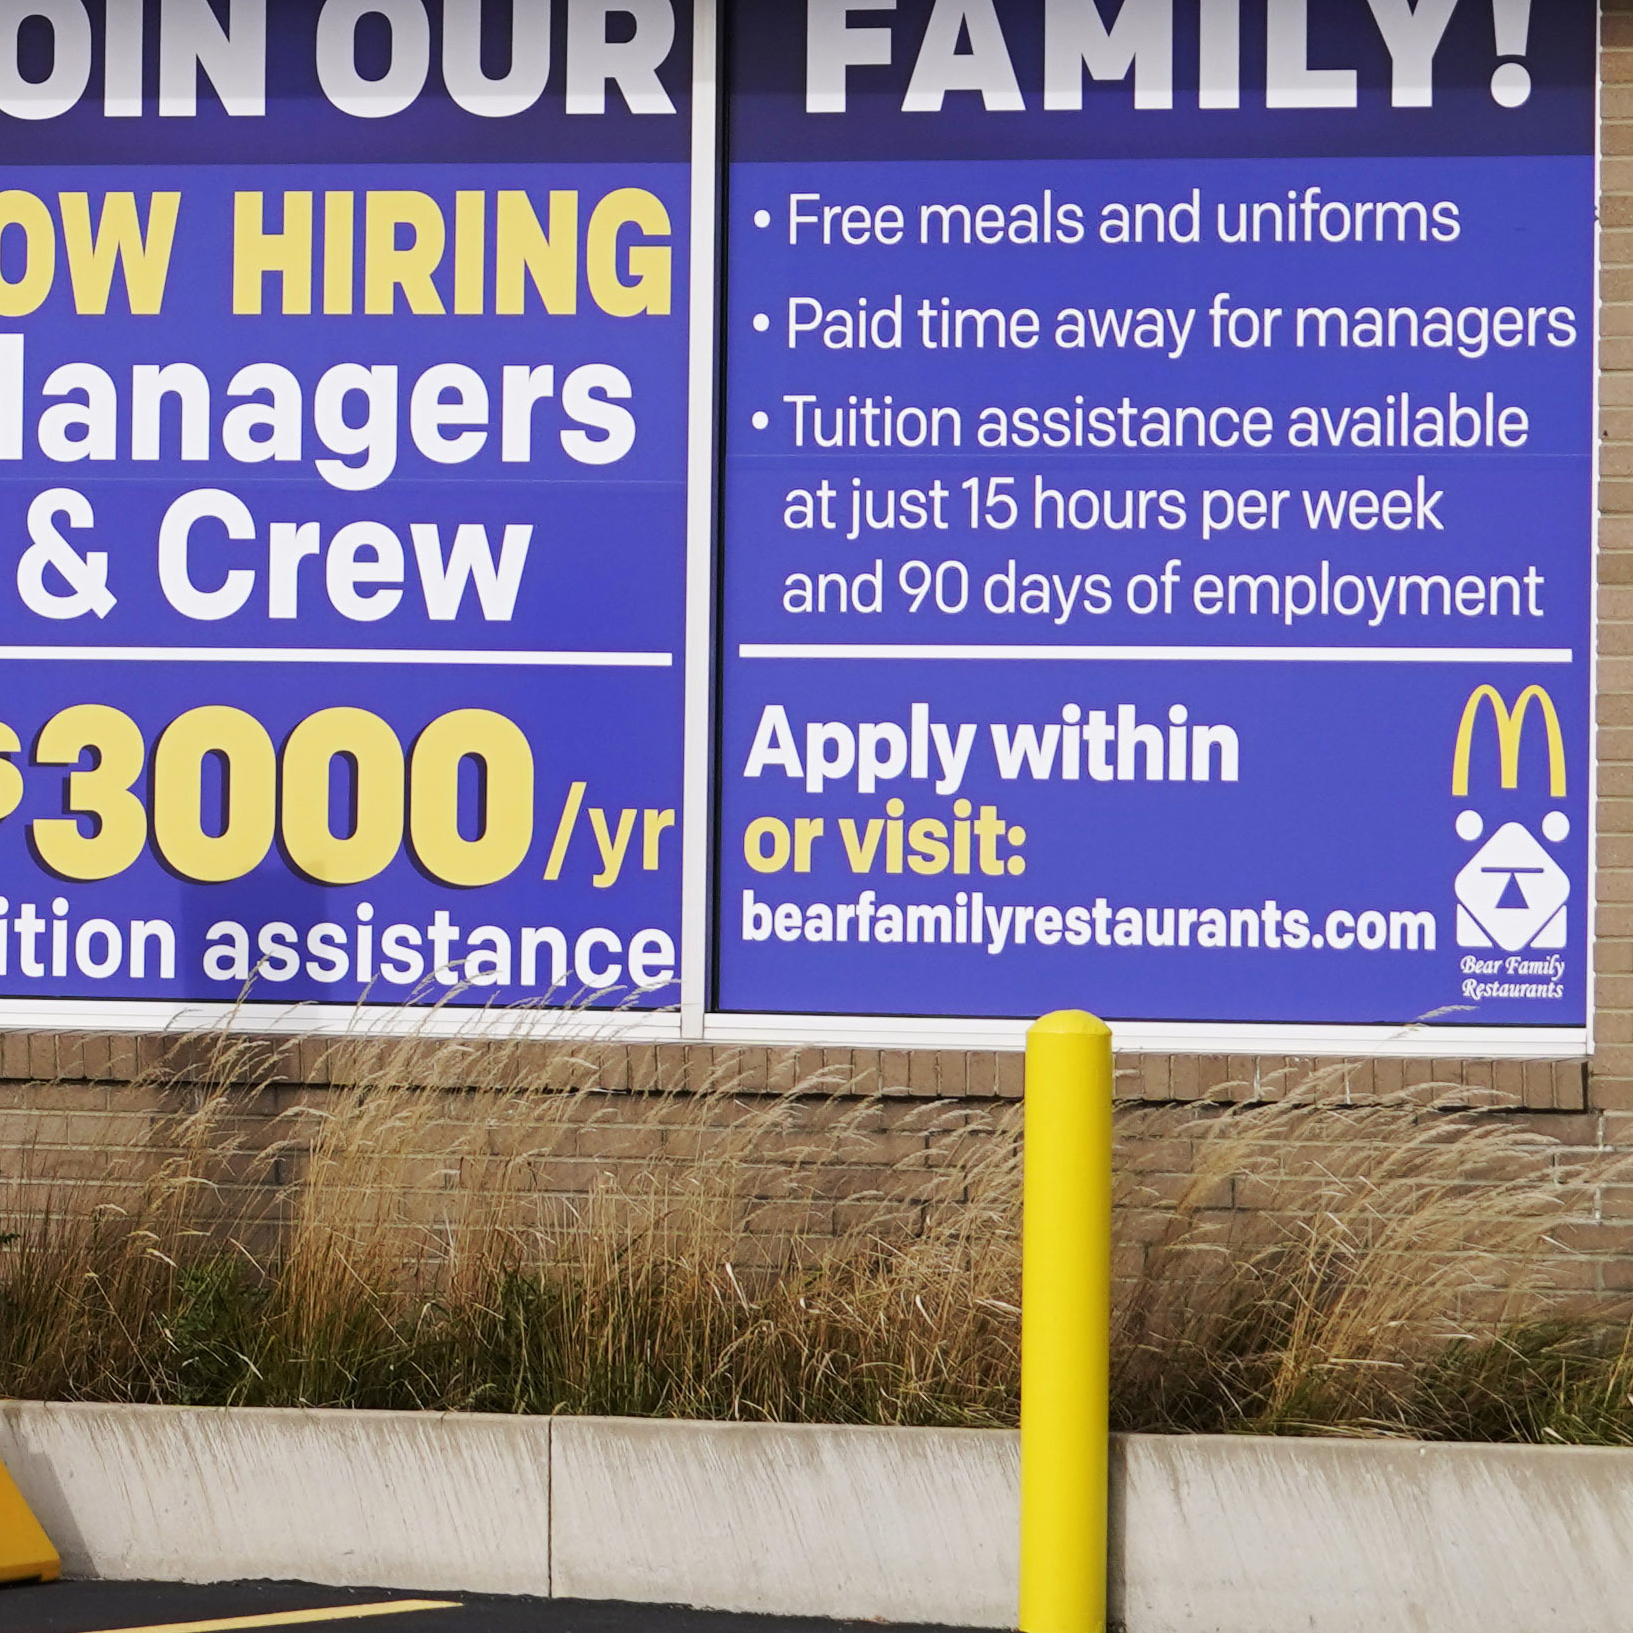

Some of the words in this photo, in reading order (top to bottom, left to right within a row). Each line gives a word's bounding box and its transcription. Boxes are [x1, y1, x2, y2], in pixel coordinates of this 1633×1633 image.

[790, 194, 904, 244] Free
[921, 190, 1084, 244] meals
[1100, 189, 1199, 243] and
[1218, 187, 1460, 242] uniforms
[233, 188, 671, 317] HIRING
[789, 295, 901, 349] Paid
[918, 297, 1039, 348] time
[1055, 308, 1195, 358] away
[1209, 293, 1282, 348] for
[1297, 307, 1576, 358] managers
[783, 395, 960, 447] Tuition
[978, 395, 1272, 447] assistance
[1289, 392, 1528, 447] available
[784, 480, 836, 529] at
[847, 478, 949, 540] just
[962, 477, 1017, 529] 15
[1035, 475, 1186, 529] hours
[1203, 490, 1290, 540] per
[1302, 475, 1444, 530] week
[17, 488, 117, 619] &
[158, 488, 533, 621] Crew
[783, 559, 882, 613] and
[899, 560, 968, 613] 90
[984, 559, 1112, 624] days
[1127, 559, 1181, 614] of
[1194, 561, 1544, 626] employment
[744, 703, 977, 794] Apply
[990, 703, 1238, 781] within
[744, 817, 824, 873] or
[840, 799, 1026, 875] visit:
[203, 902, 677, 985] assistance
[743, 890, 1436, 955] bearfamilyrestaurants.com
[1460, 955, 1499, 974] Bear
[1505, 954, 1565, 981] Family
[1462, 977, 1563, 1000] Restaurants
